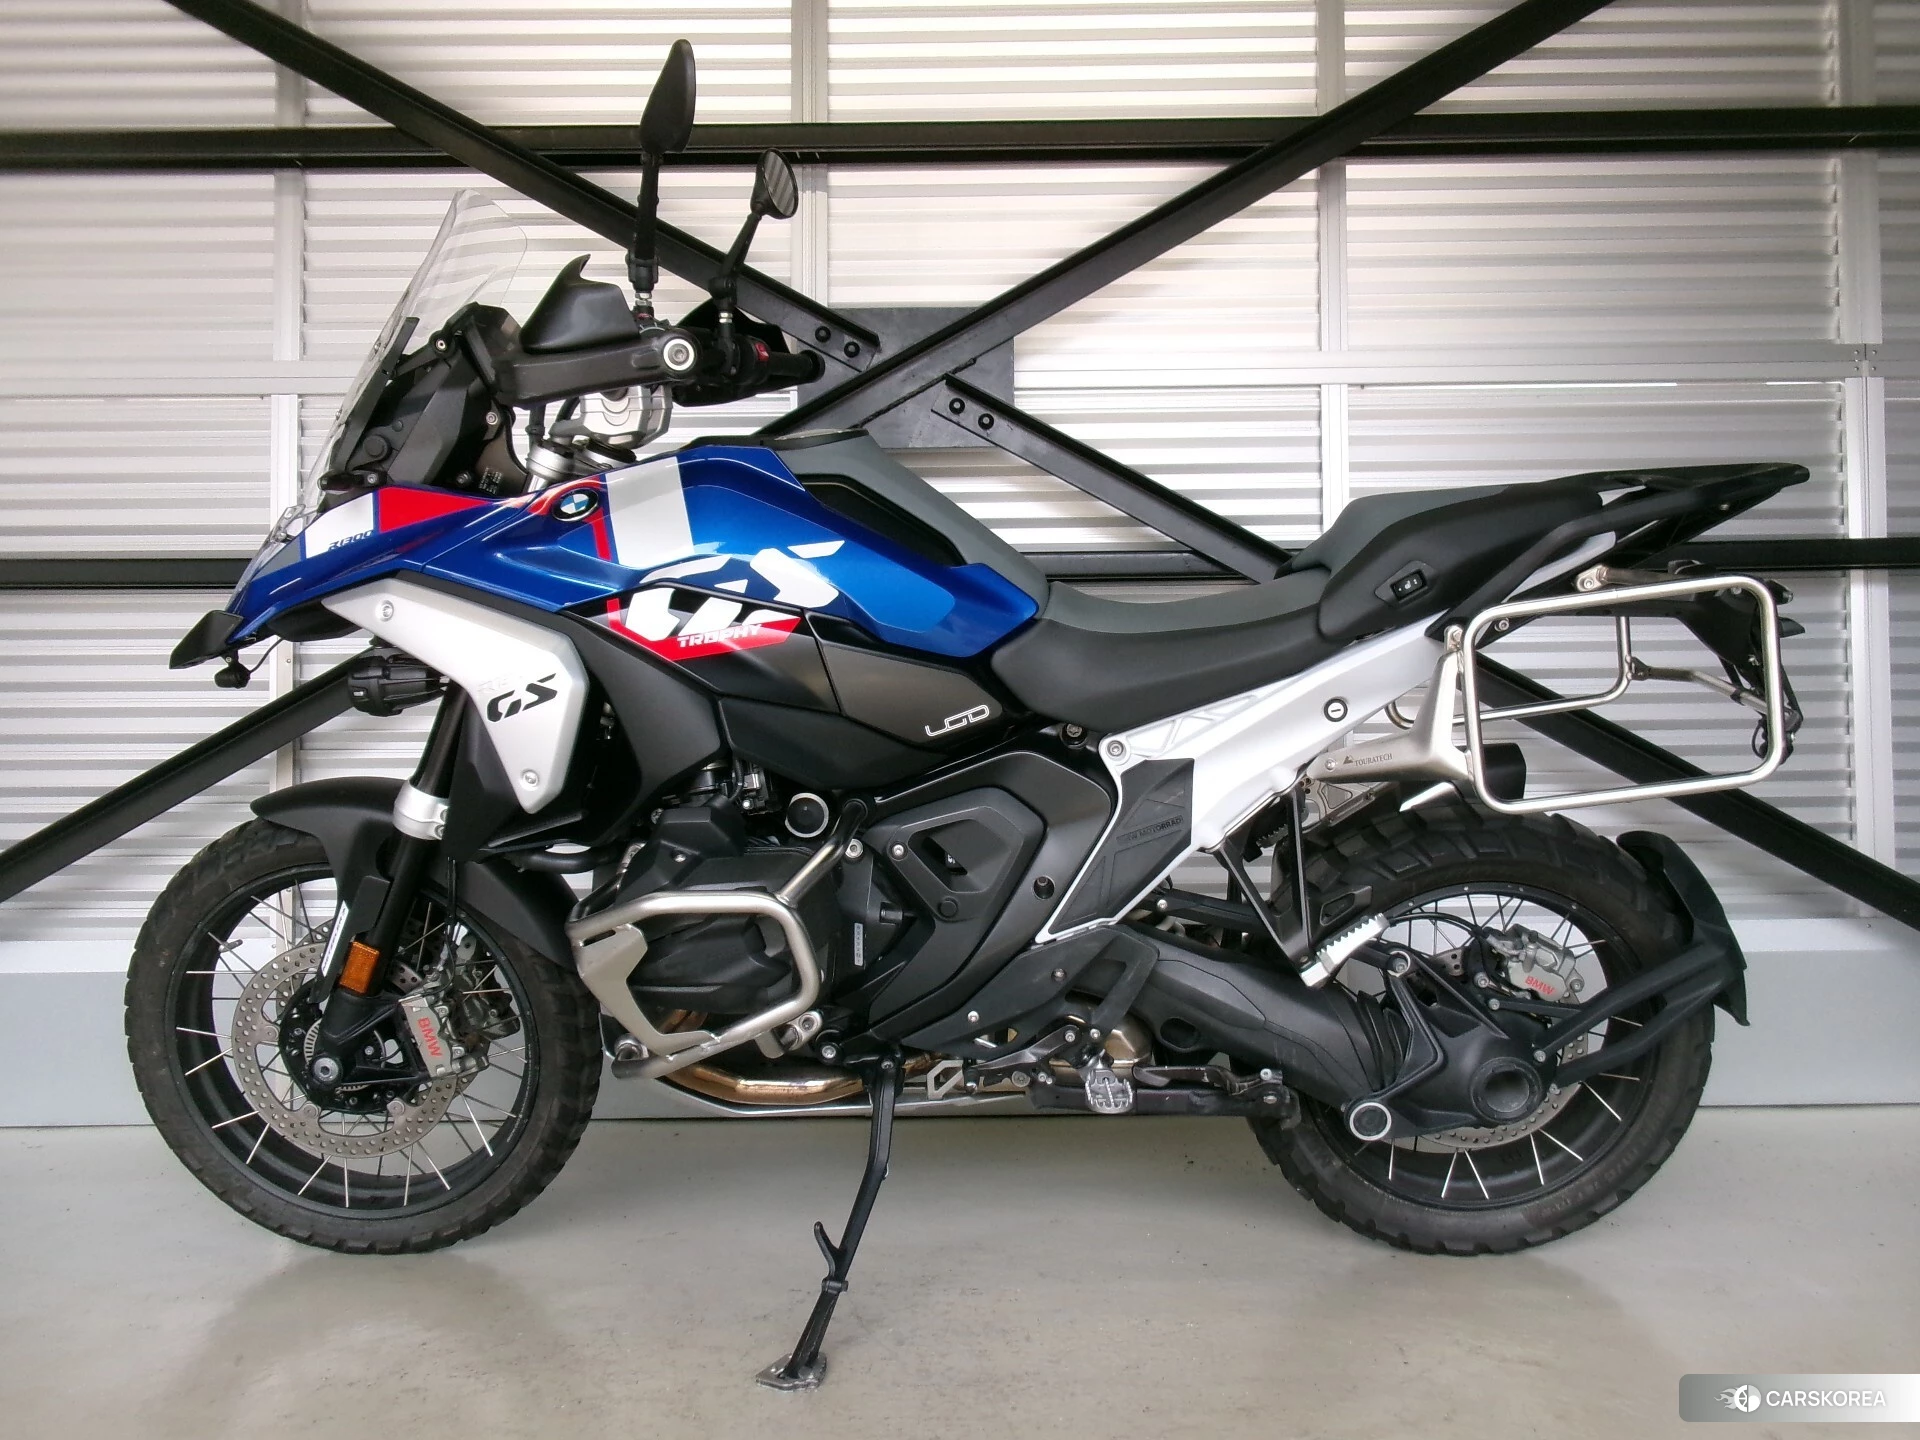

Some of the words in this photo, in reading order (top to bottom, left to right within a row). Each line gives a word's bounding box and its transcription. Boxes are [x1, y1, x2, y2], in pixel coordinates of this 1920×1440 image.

[677, 624, 763, 648] TROPHY
[487, 673, 558, 722] GS
[1355, 753, 1393, 766] TOURATECH
[1525, 975, 1556, 995] BMW
[418, 1016, 443, 1056] BMW
